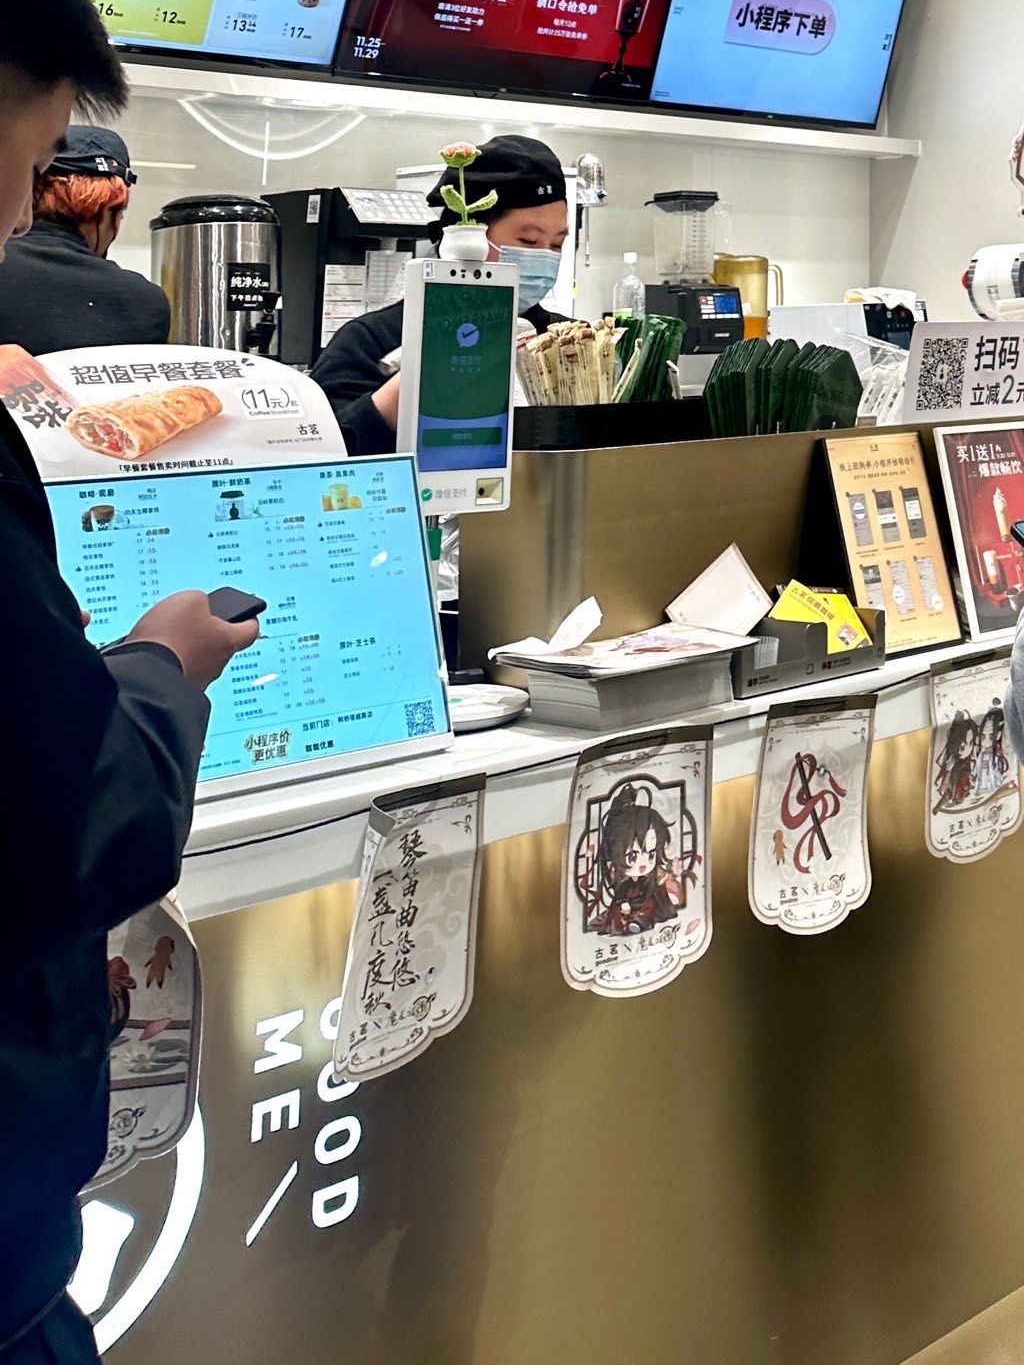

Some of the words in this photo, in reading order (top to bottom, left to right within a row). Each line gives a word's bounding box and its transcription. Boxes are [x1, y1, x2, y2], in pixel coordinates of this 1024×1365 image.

[162, 10, 178, 24] 12
[735, 1, 828, 40] 小程序下单
[232, 19, 247, 32] 13
[290, 26, 305, 39] 17
[353, 46, 379, 59] 11.29
[230, 276, 262, 288] 纯净水
[69, 358, 243, 386] 超值早餐套餐
[296, 423, 319, 436] 古茗
[956, 443, 997, 463] 买1送1
[434, 488, 467, 500] 微信支付
[246, 730, 290, 750] 小程序价
[253, 744, 287, 761] 更优惠
[250, 1008, 304, 1143] ME
